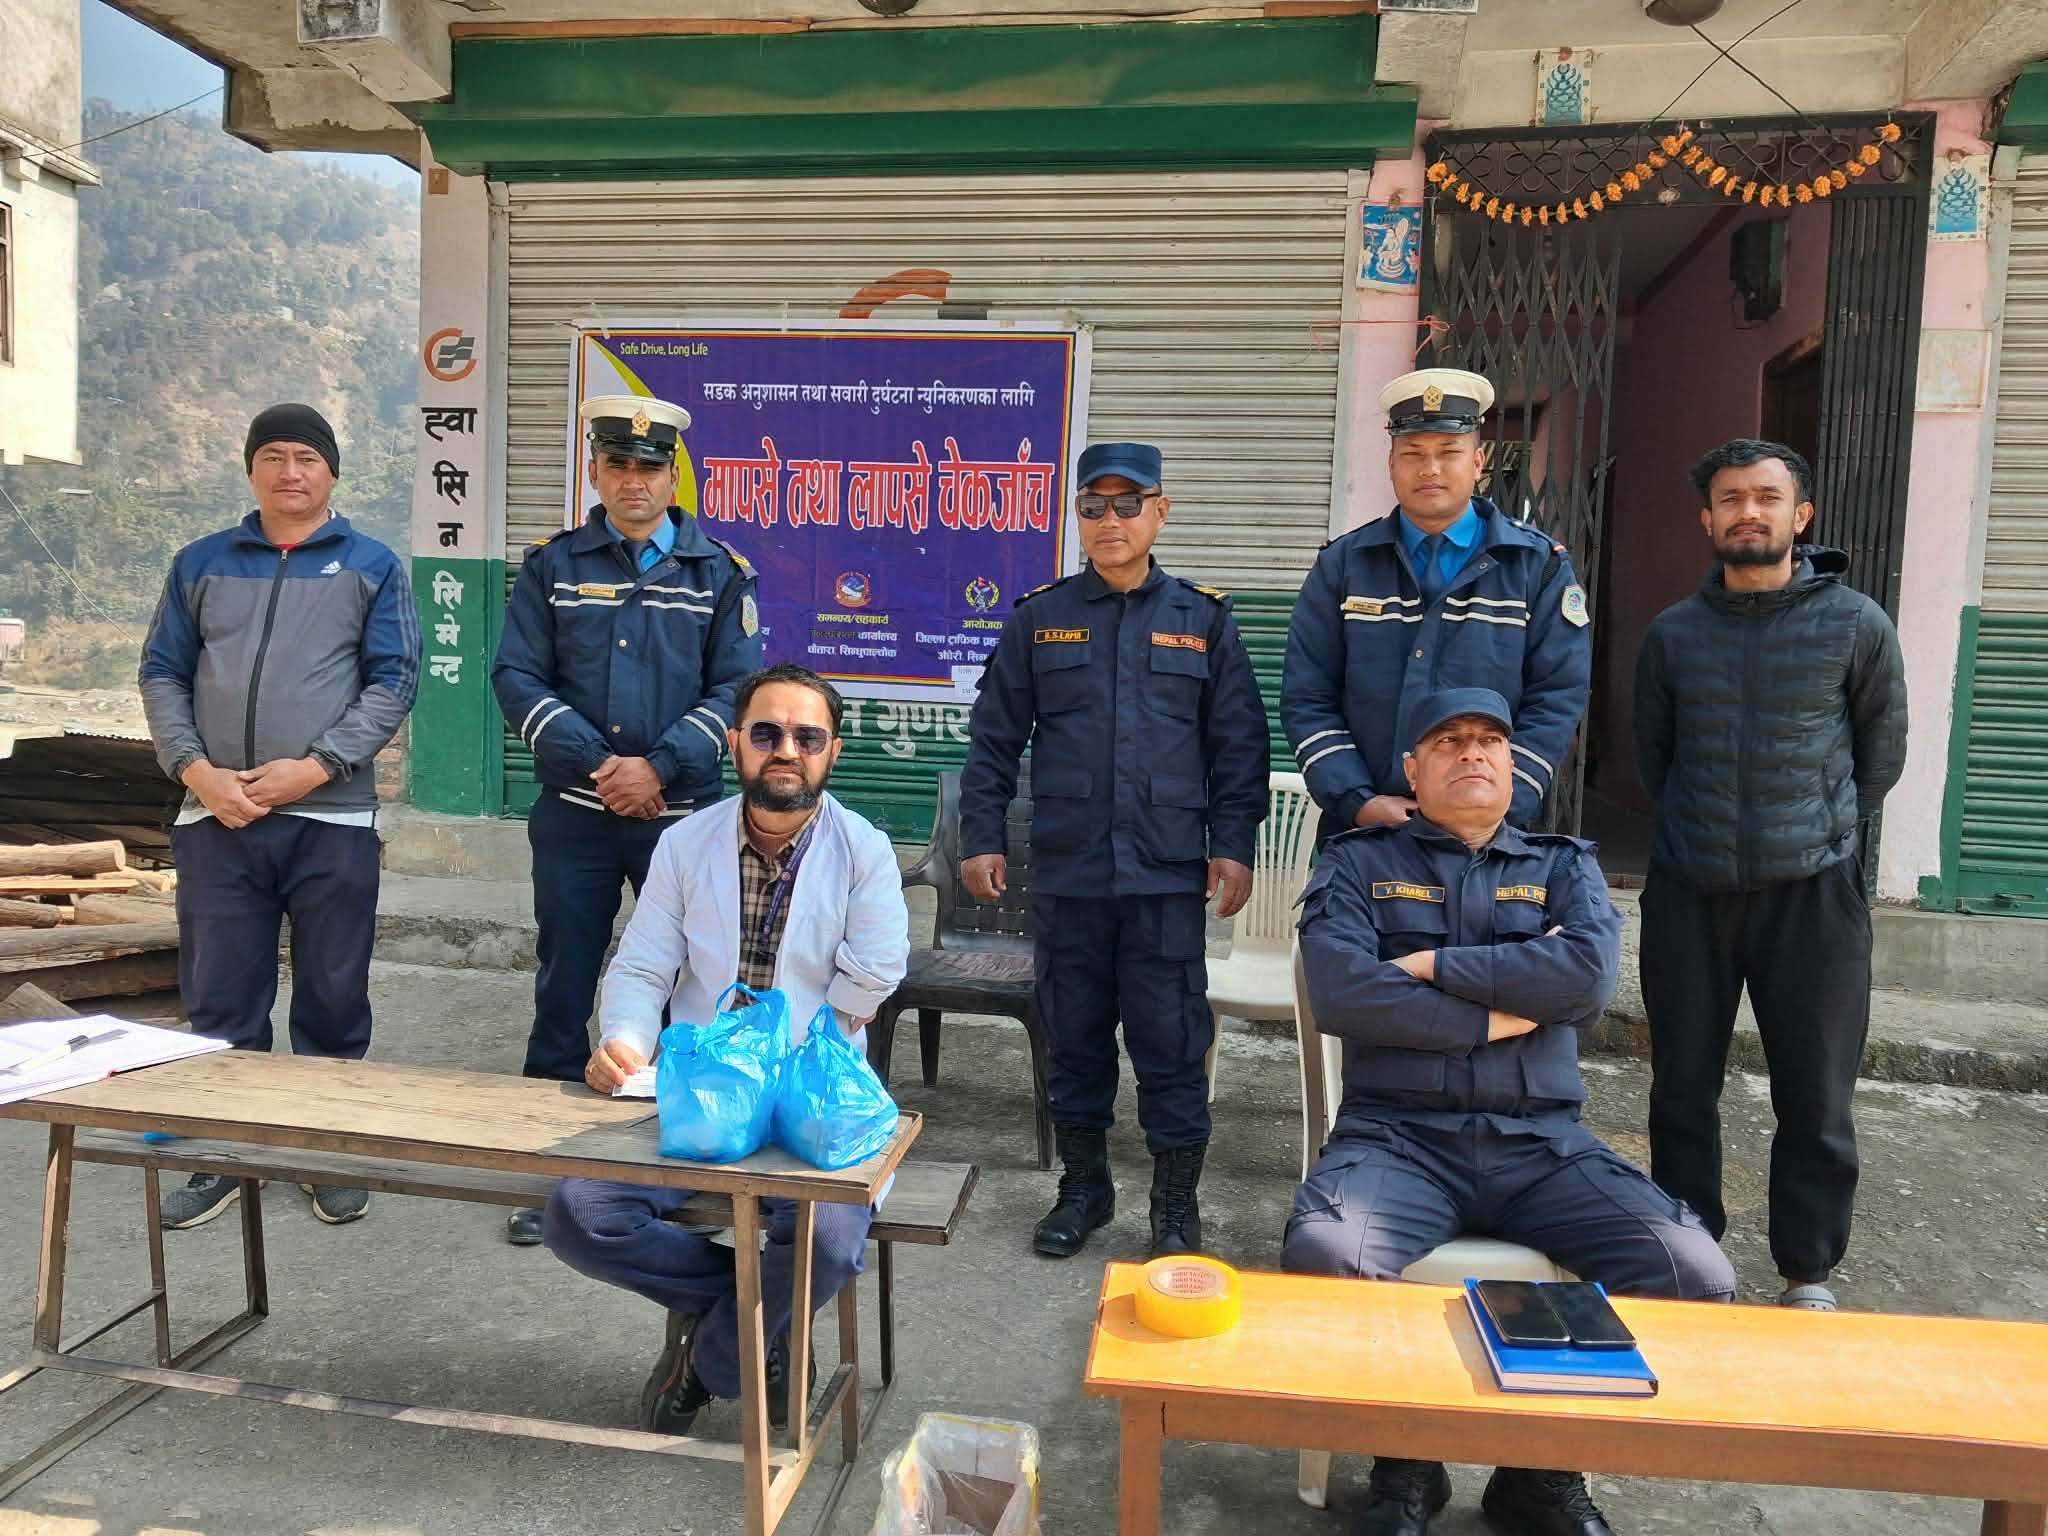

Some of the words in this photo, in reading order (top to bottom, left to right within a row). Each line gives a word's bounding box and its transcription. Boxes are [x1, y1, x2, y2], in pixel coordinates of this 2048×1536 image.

[620, 342, 639, 354] Safe
[641, 342, 666, 356] Drive,
[668, 343, 689, 357] Long
[692, 343, 708, 355] Life
[703, 383, 737, 400] सडक
[740, 384, 798, 410] अनुशासन
[801, 385, 827, 402] तथा
[830, 380, 868, 404] सवारी
[871, 379, 914, 415] दुर्घटना
[917, 380, 997, 414] न्युनिकरणका
[1000, 381, 1035, 407] लागि
[703, 436, 782, 529] मापसे
[786, 459, 843, 528] तथा
[848, 440, 932, 534] लापसे
[938, 436, 1055, 532] चेकजाँच
[1496, 887, 1528, 897] NEPAL
